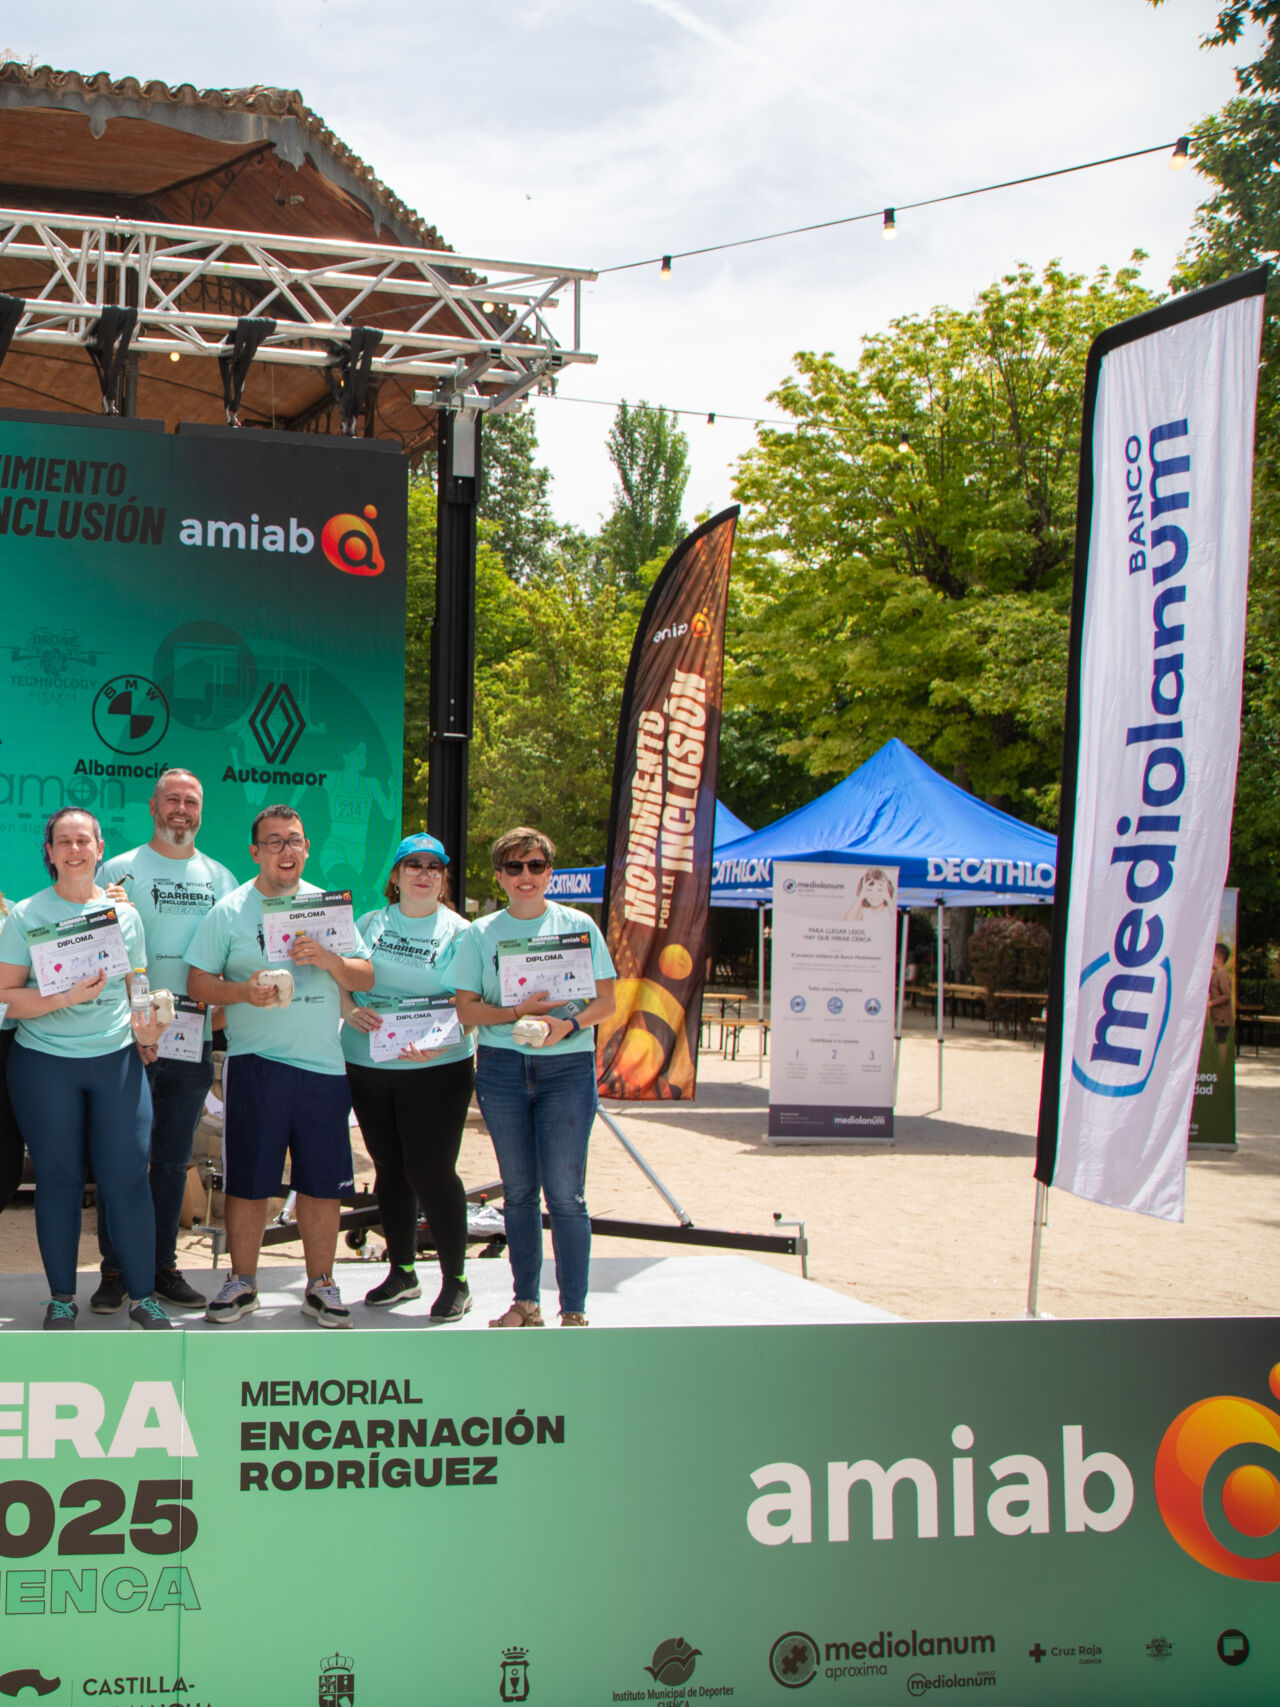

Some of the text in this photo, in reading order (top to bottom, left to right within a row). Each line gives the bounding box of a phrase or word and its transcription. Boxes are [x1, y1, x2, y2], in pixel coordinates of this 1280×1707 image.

[1125, 434, 1147, 575] BANCO
[179, 513, 315, 554] amiab
[1090, 417, 1191, 1067] mediolanum
[222, 765, 327, 787] Automaor
[659, 668, 706, 929] POR LA INCLUSIÓN
[624, 710, 665, 927] MOVIMIENTO
[712, 858, 771, 885] CATHLON
[927, 857, 1056, 888] DECATHLO
[545, 874, 591, 894] ECATHLON
[797, 881, 844, 889] mediolanum
[159, 892, 210, 901] CARRERA
[289, 910, 326, 920] DIPLOMA
[57, 934, 94, 948] DIPLOMA
[525, 953, 563, 963] DIPLOMA
[396, 1012, 432, 1021] DIPLOMA
[831, 1050, 837, 1060] 2
[835, 1116, 885, 1125] mediolanum
[240, 1379, 423, 1407] MEMORIAL
[240, 1408, 565, 1451] ENCARNACIÓN
[239, 1452, 498, 1492] RODRÍGUEZ
[746, 1424, 1134, 1546] amiab
[824, 1629, 995, 1661] mediolanum
[1050, 1645, 1102, 1657] Cruz Roja
[824, 1662, 887, 1682] aproxima
[911, 1673, 996, 1690] mediolanum
[83, 1676, 195, 1696] CASTILLA-
[612, 1685, 734, 1702] Instituto Municipal de Deportes
